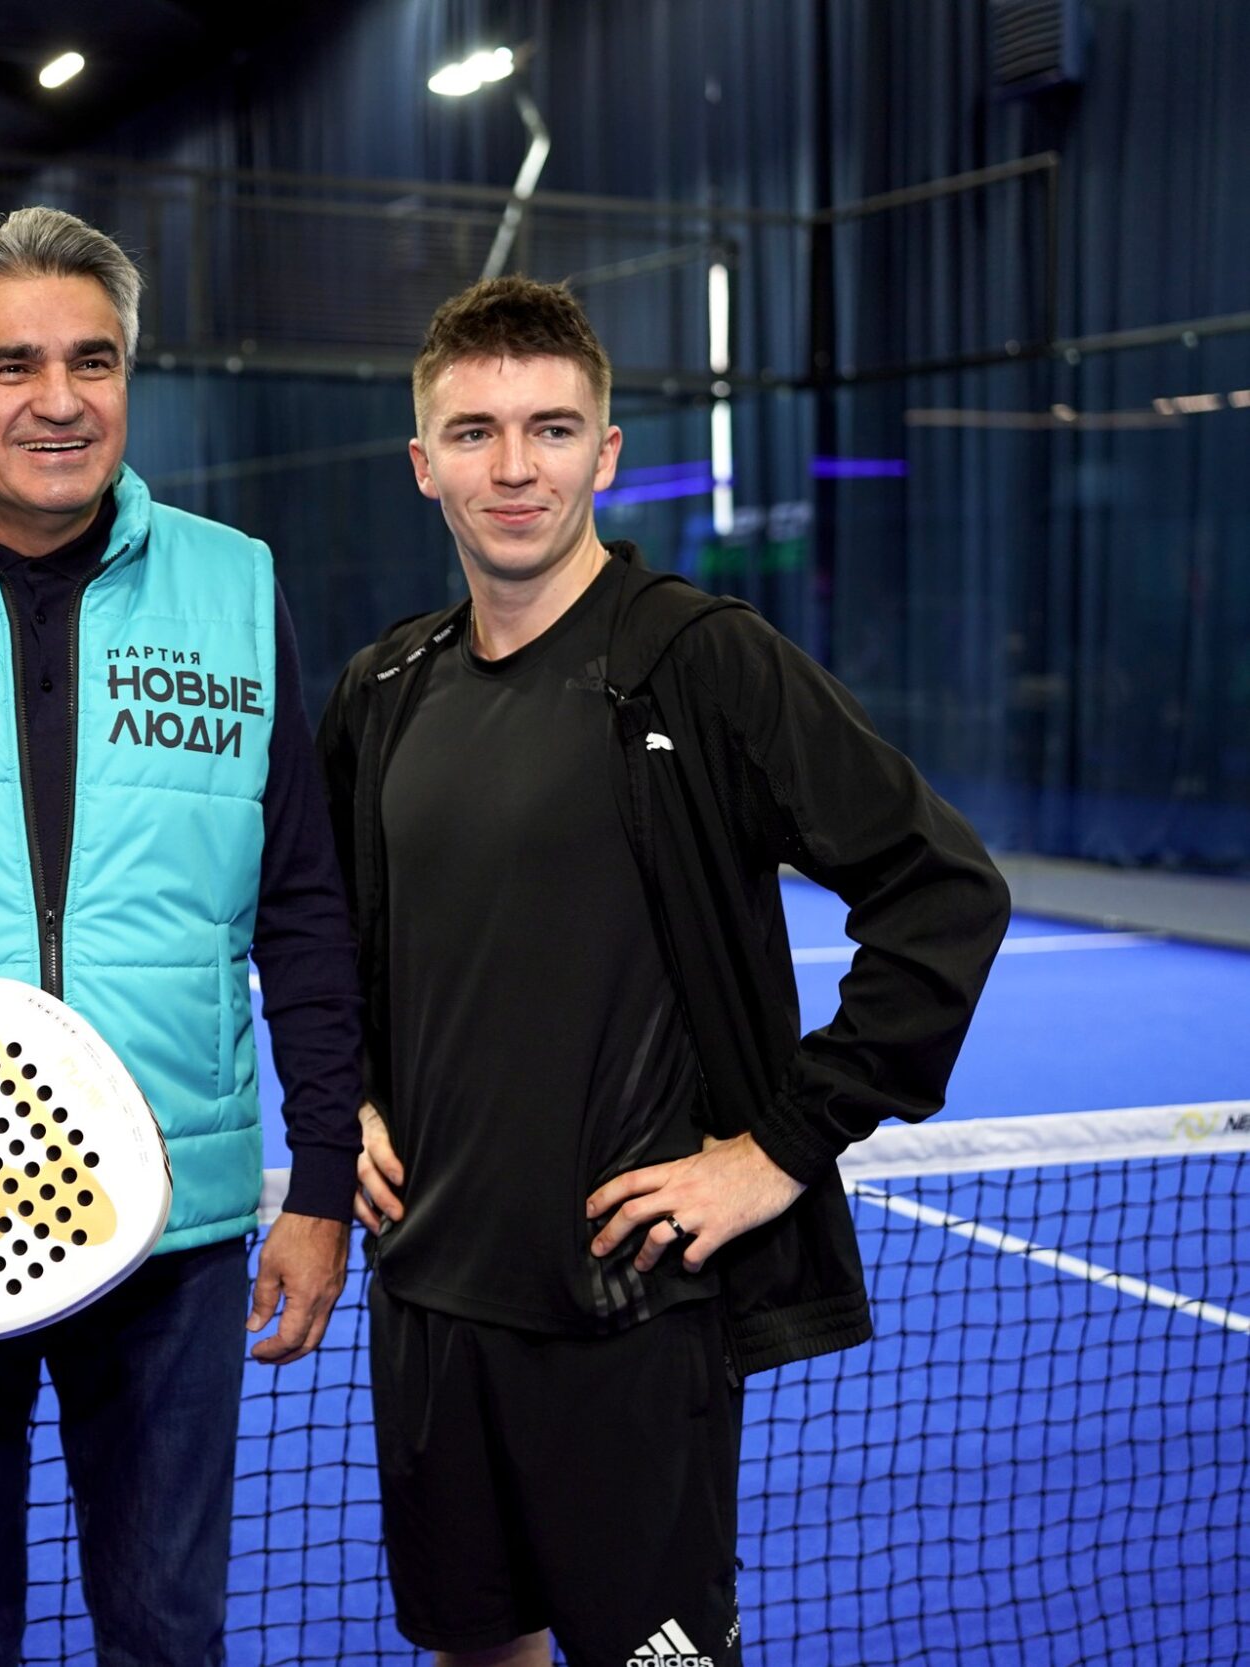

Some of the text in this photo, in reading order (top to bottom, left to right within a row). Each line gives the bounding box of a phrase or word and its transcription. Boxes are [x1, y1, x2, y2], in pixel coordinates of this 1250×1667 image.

[107, 645, 201, 665] ПАРТИЯ
[107, 664, 264, 716] НОВЫЕ
[108, 708, 242, 758] ЛЮДИ
